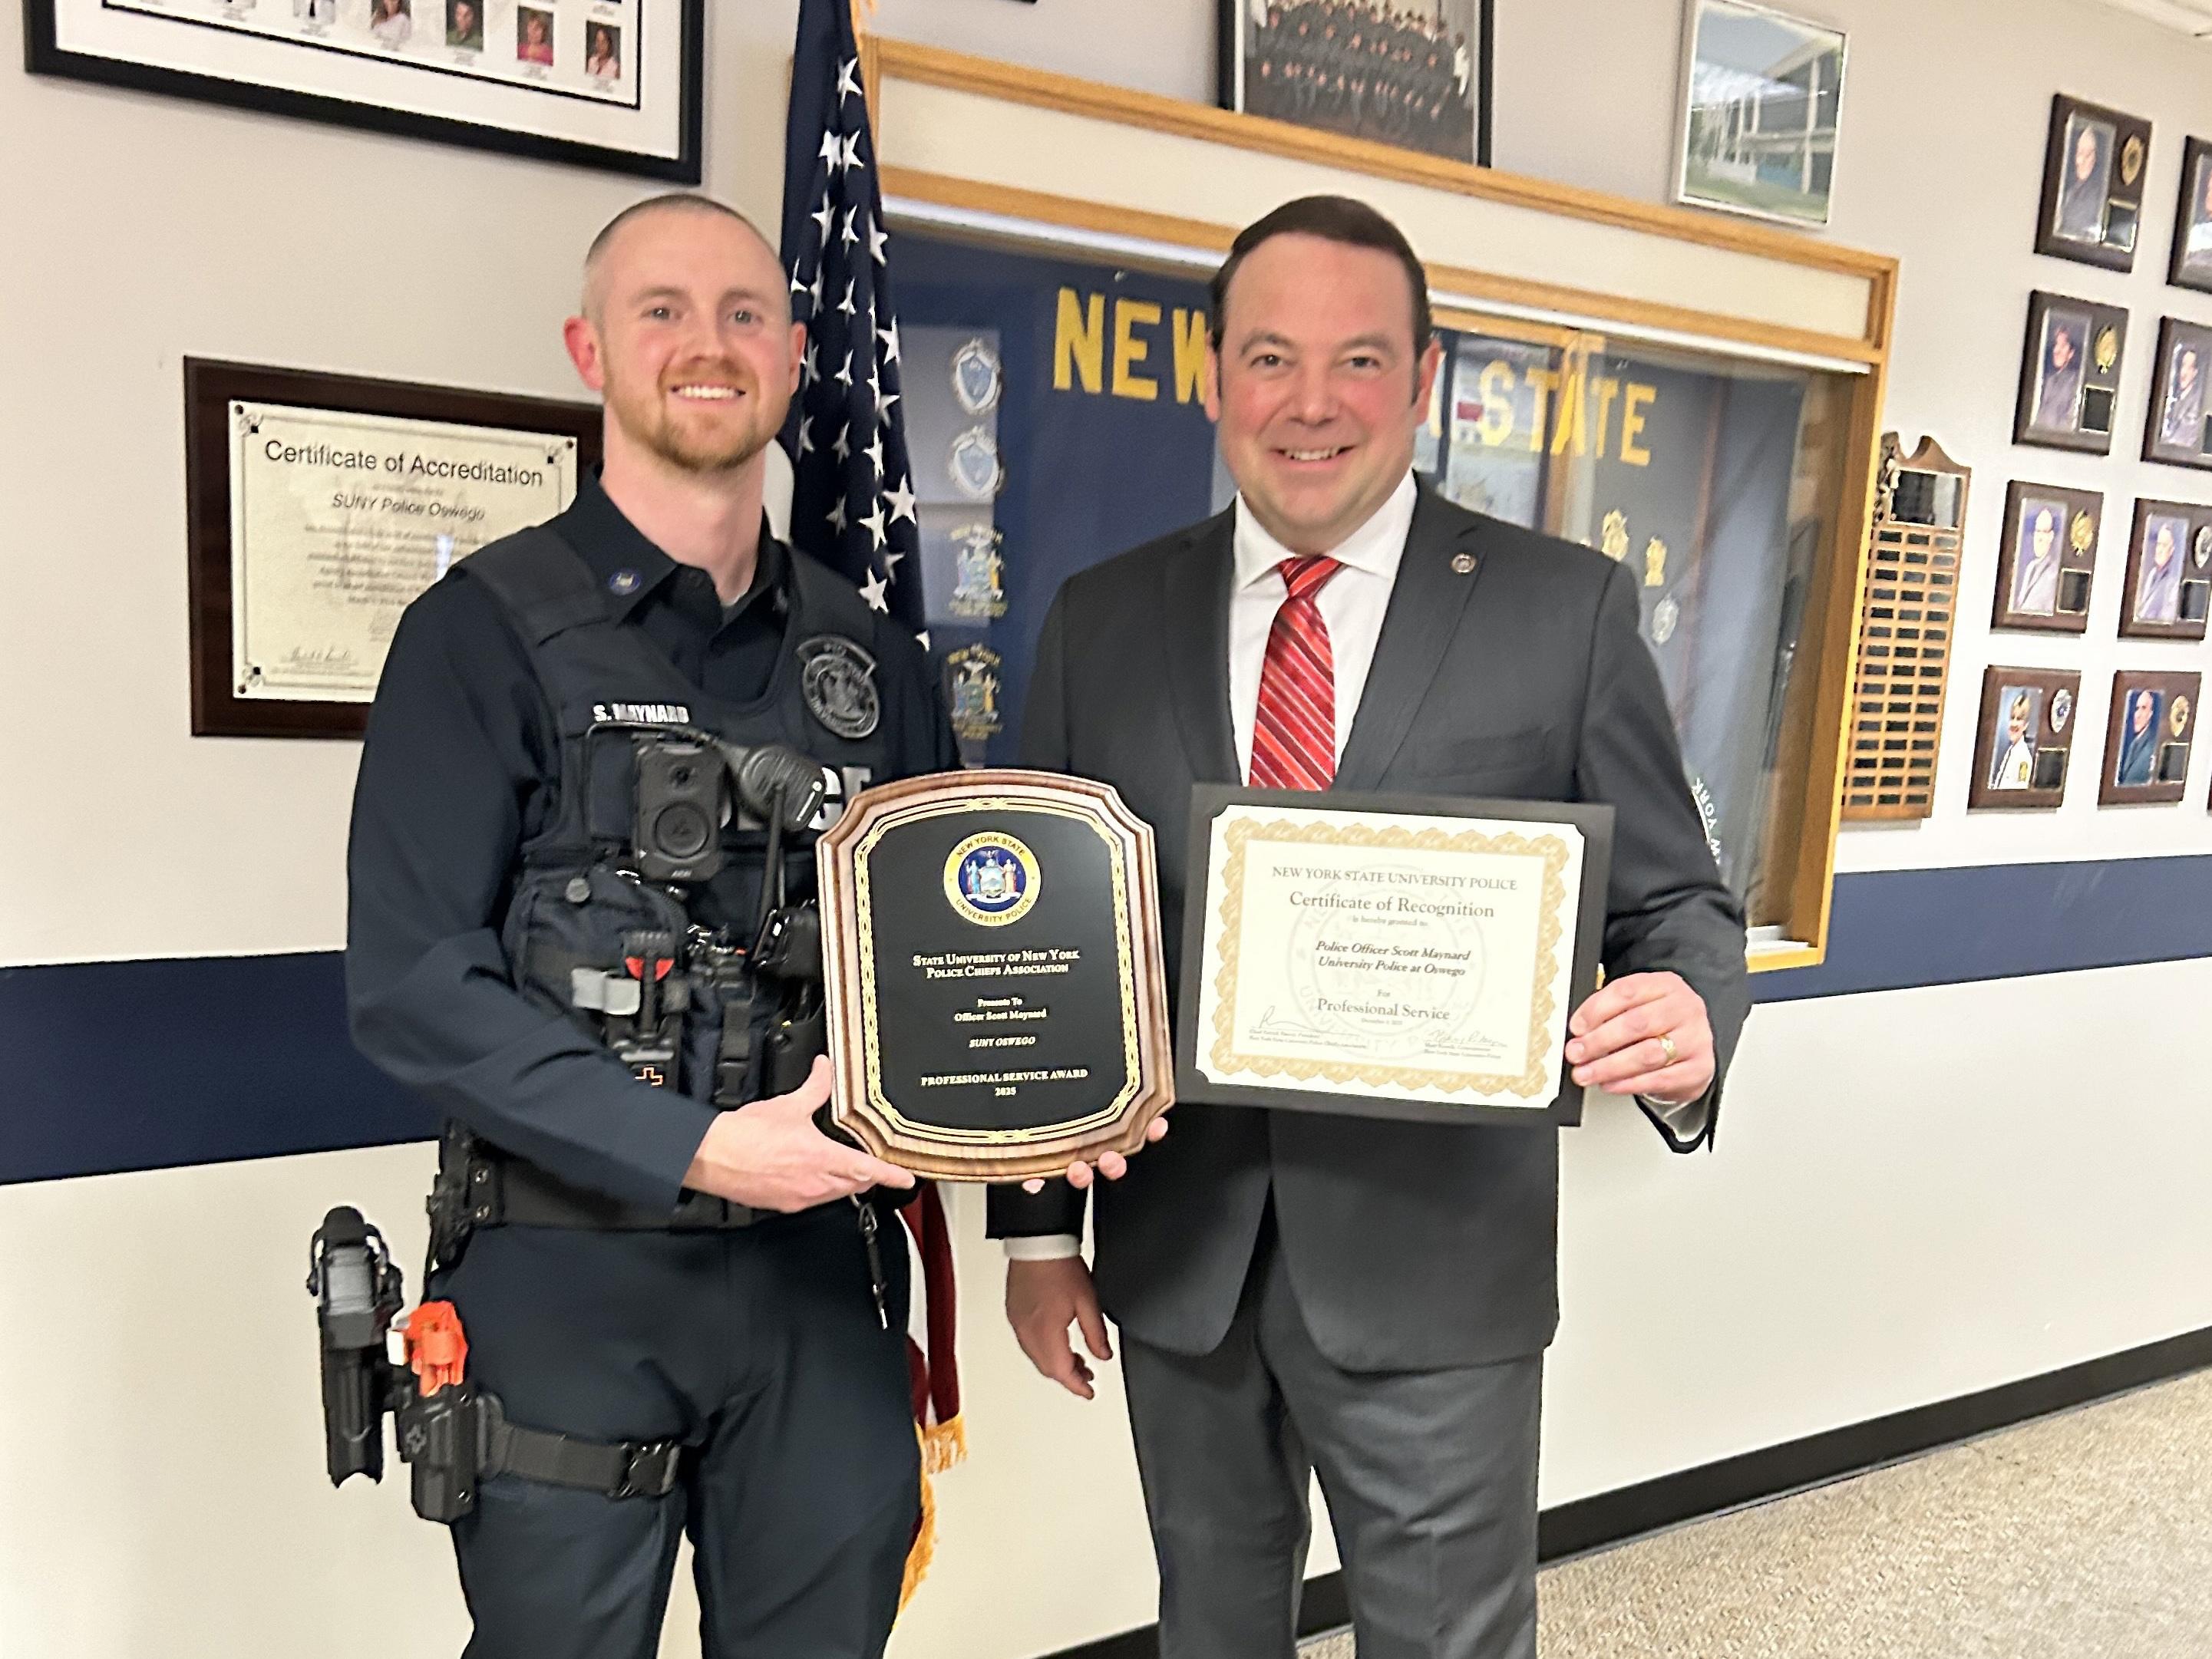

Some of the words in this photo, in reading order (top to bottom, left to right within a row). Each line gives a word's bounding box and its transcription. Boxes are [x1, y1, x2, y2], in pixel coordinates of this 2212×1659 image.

[1053, 286, 1207, 405] NEW
[1476, 359, 1658, 467] STATE
[265, 440, 377, 470] Certificate
[385, 451, 404, 473] of
[411, 454, 543, 486] Accreditation
[332, 493, 377, 510] SUNY
[381, 497, 423, 516] Police
[429, 503, 486, 523] Oswego
[593, 704, 612, 722] S.
[612, 703, 689, 724] MAYNARD
[956, 841, 973, 857] NEW
[975, 836, 999, 845] YORK
[1002, 838, 1025, 856] STATE
[1272, 866, 1303, 879] NEW
[1305, 867, 1342, 880] YORK
[1344, 870, 1385, 883] STATE
[1388, 872, 1468, 889] UNIVERSITY
[1470, 876, 1517, 891] POLICE
[956, 899, 1002, 922] UNIVERSITY
[1005, 898, 1032, 920] POLICE
[1289, 891, 1372, 910] Certificate
[1376, 895, 1394, 912] of
[1398, 897, 1494, 918] Recognition
[1315, 941, 1349, 953] Police
[1351, 942, 1389, 955] Officer
[1391, 945, 1419, 958] Scott
[1421, 948, 1471, 961] Maynard
[1318, 956, 1373, 971] University
[1375, 960, 1408, 973] Police
[1409, 965, 1422, 974] at
[1424, 963, 1466, 978] Oswego
[1377, 988, 1392, 998] For
[1317, 998, 1398, 1017] Professional
[1401, 1003, 1451, 1021] Service
[969, 1038, 995, 1048] SUNY
[995, 1037, 1036, 1047] OSWEGO
[920, 1073, 1002, 1087] PROFESSIONAL
[1002, 1070, 1049, 1082] SERVICE
[1049, 1069, 1088, 1080] AWARD
